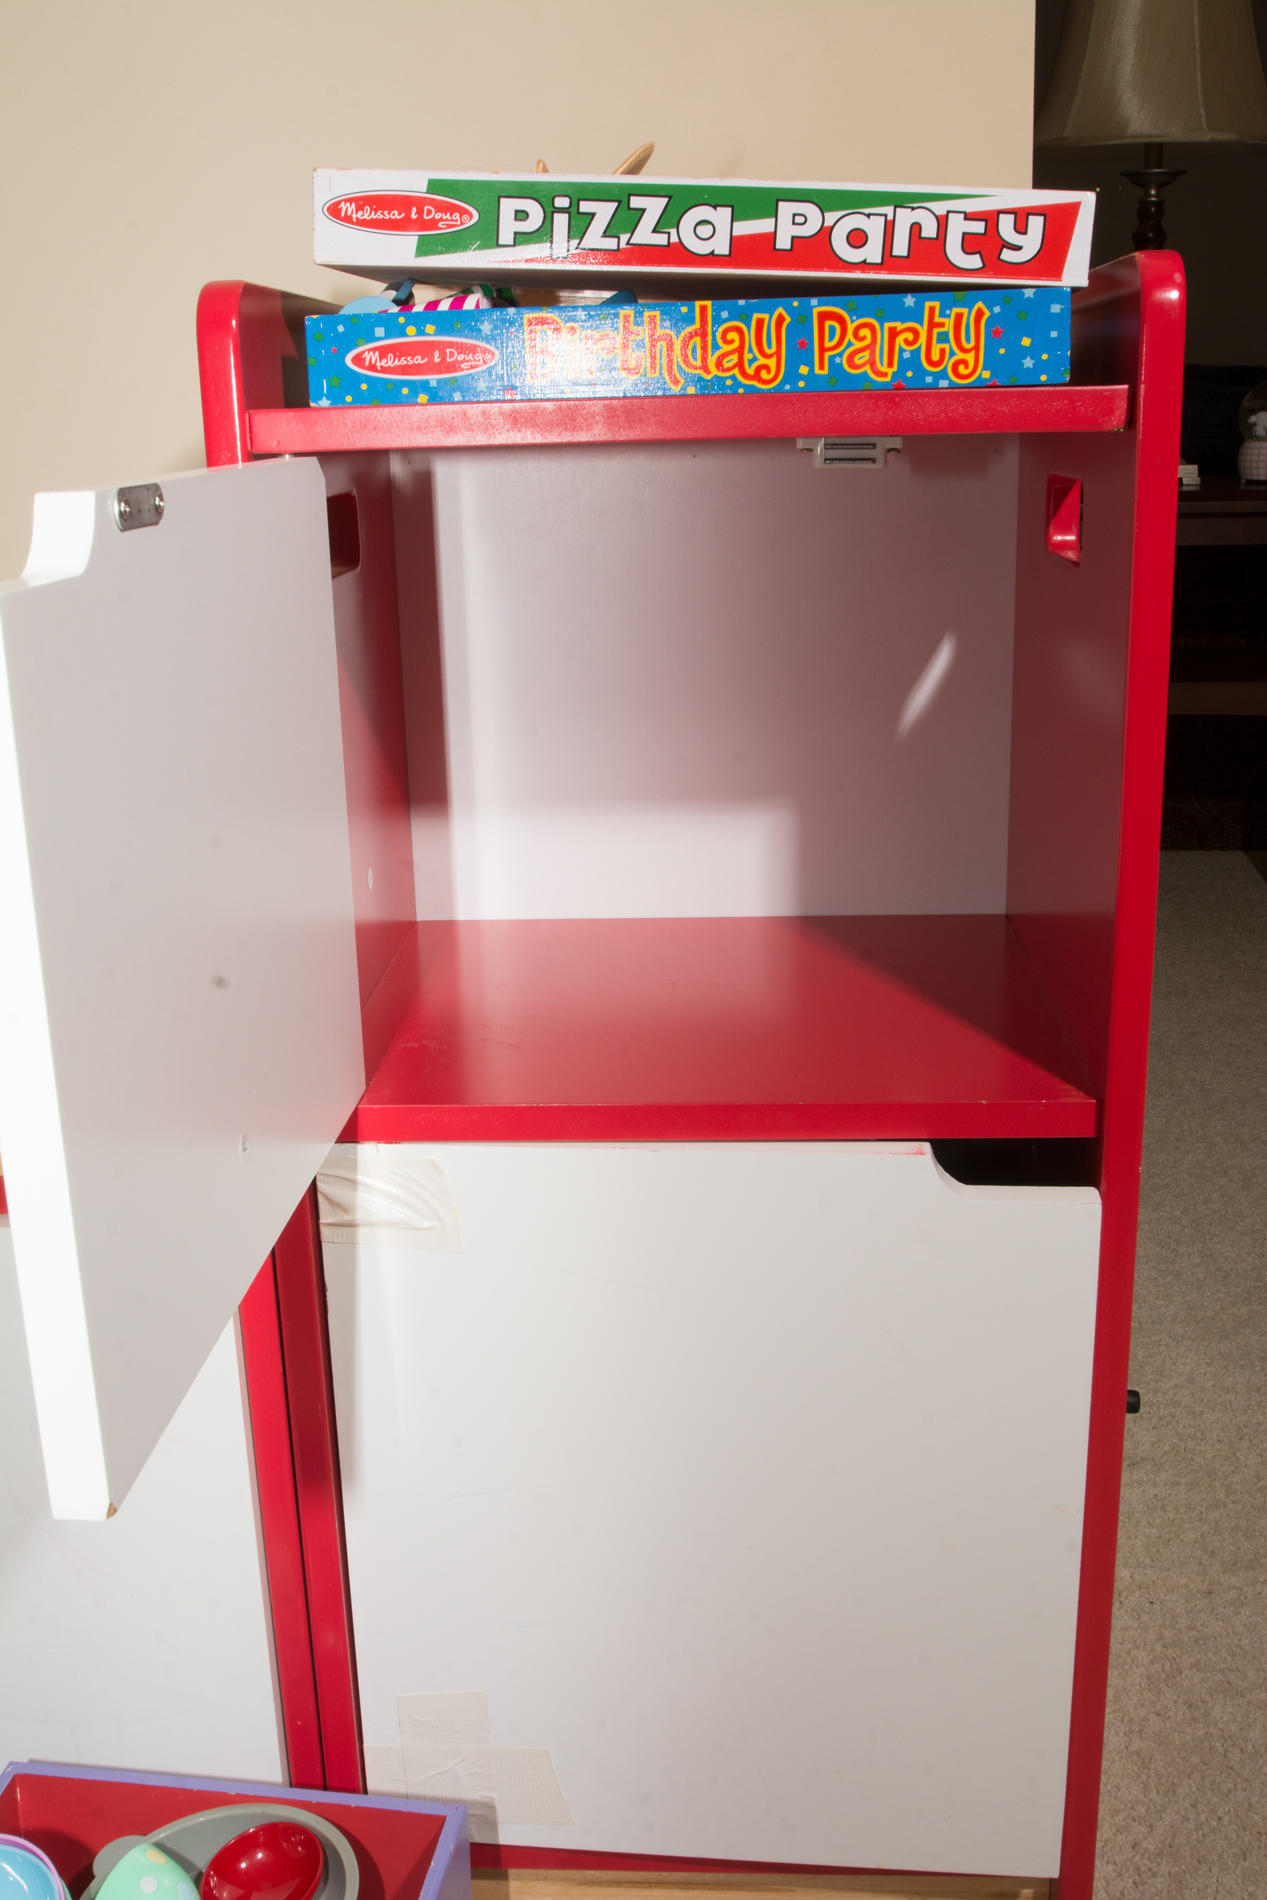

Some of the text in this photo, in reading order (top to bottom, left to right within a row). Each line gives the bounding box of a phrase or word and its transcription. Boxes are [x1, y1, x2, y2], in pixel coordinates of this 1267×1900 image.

[338, 201, 405, 222] Melissa
[410, 206, 418, 219] &
[773, 199, 1047, 271] Party
[362, 350, 429, 370] Melissa
[434, 350, 442, 363] &
[523, 300, 991, 391] Birthday Party
